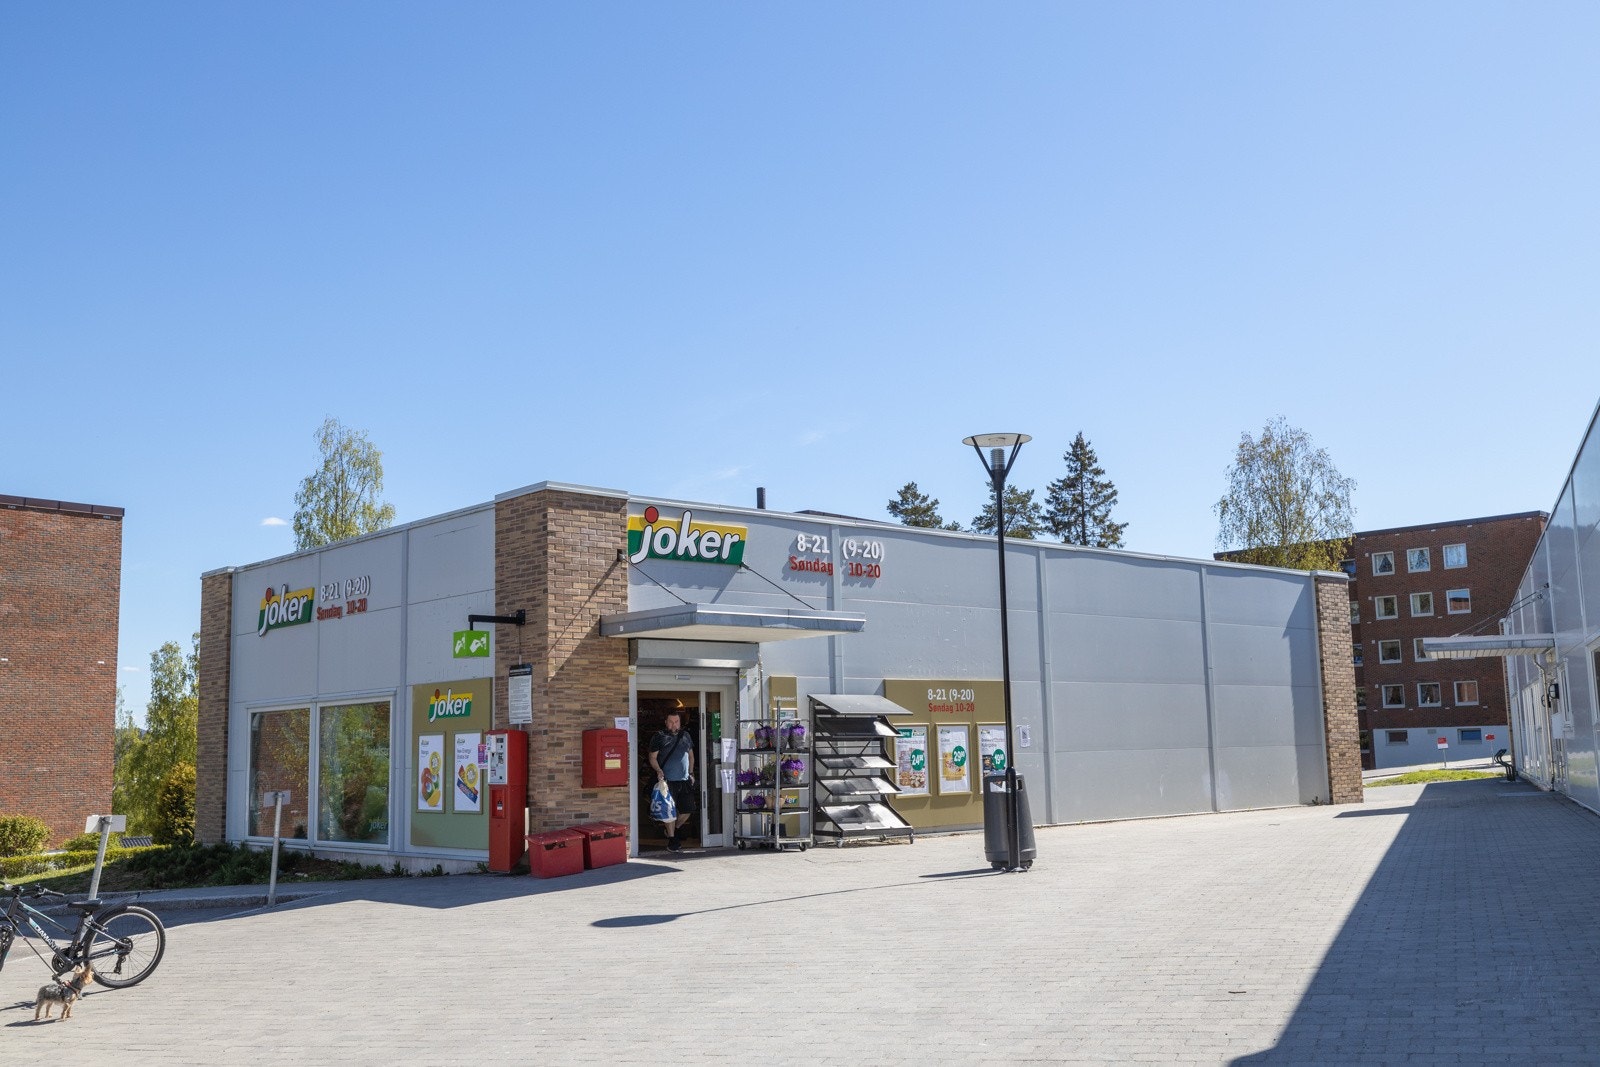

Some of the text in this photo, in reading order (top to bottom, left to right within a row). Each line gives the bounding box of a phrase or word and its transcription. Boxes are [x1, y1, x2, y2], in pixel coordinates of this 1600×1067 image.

[629, 506, 740, 564] joker
[797, 533, 885, 562] 8-21 (9-20)
[789, 555, 881, 579] Søndag 10-20
[320, 575, 371, 602] 8-21 (9-20)
[258, 583, 308, 637] joker
[346, 598, 368, 615] 10-20
[429, 688, 470, 723] joker
[927, 688, 975, 703] 8-21 (9-20)
[928, 703, 975, 714] Søndag 10-20
